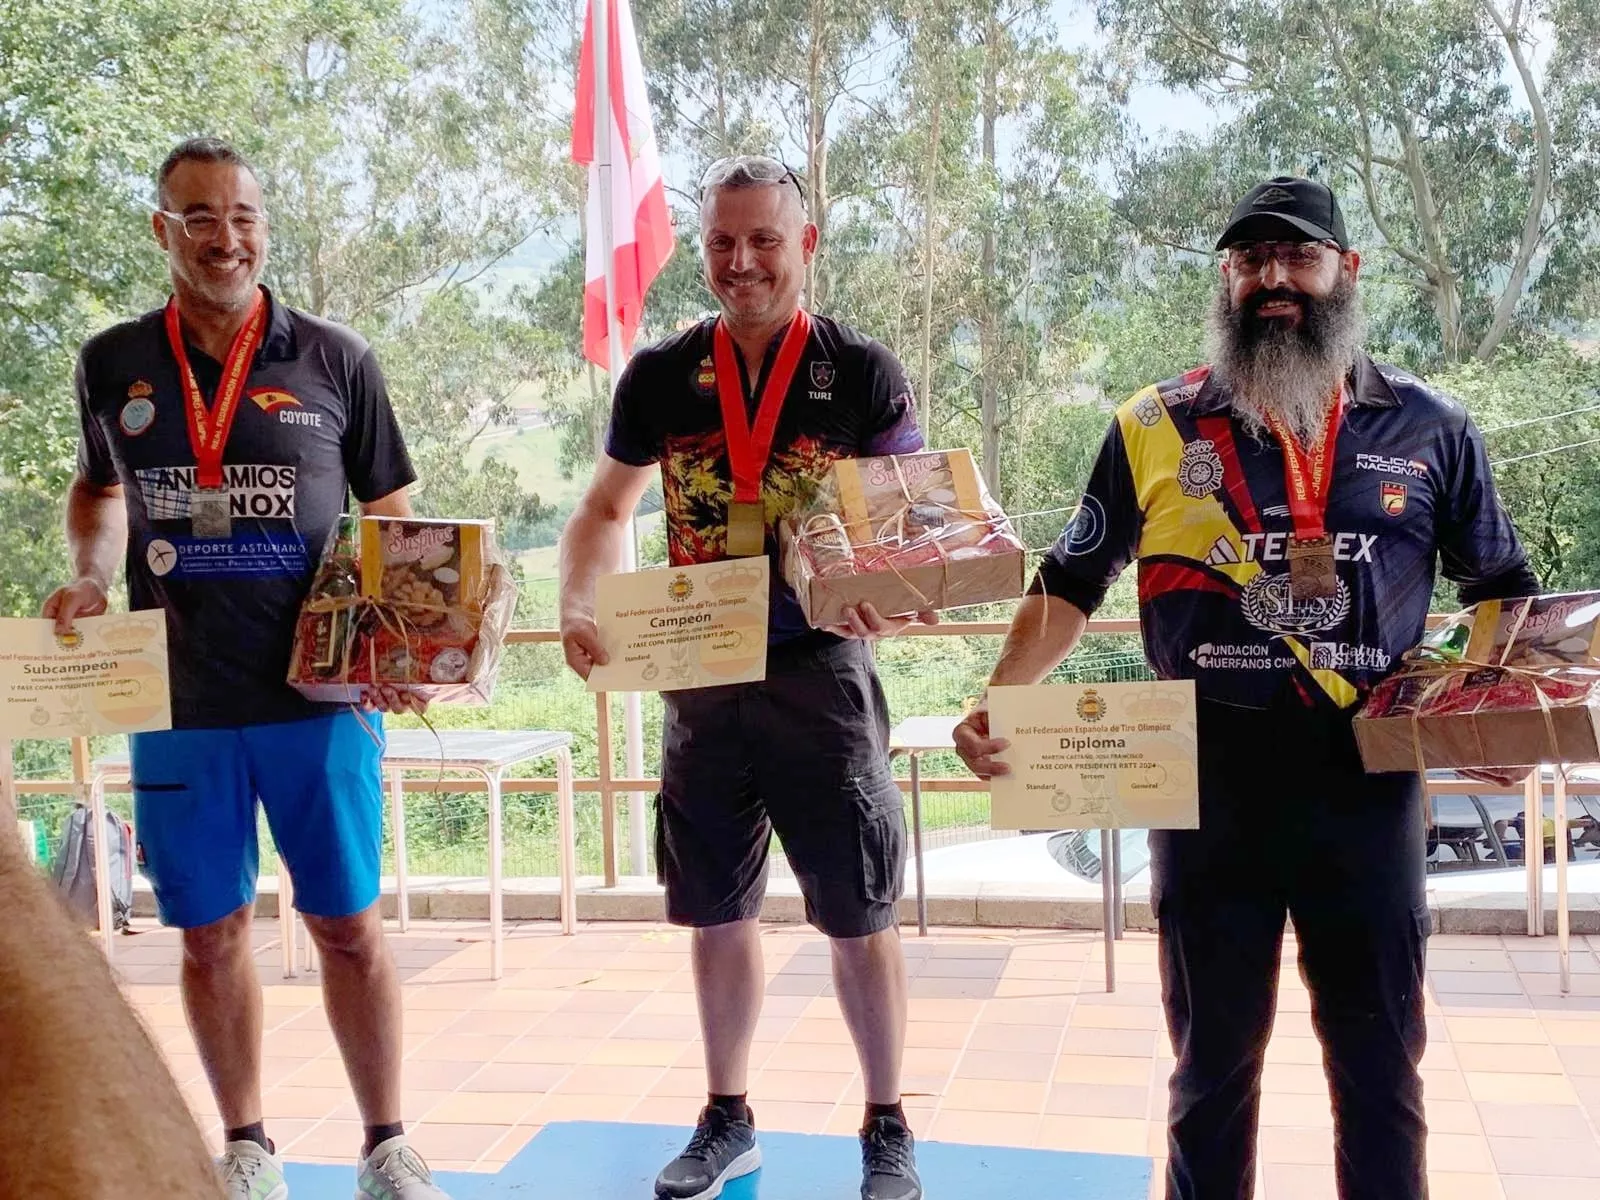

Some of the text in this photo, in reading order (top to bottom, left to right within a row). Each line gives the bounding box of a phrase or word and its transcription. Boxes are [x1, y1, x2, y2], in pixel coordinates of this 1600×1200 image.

[808, 391, 832, 401] TURI
[280, 410, 321, 427] COYOTE
[157, 466, 296, 491] ANMIOS
[868, 454, 941, 487] Supiros
[1356, 461, 1426, 482] NACIONAL
[1294, 476, 1307, 500] REAL
[388, 521, 454, 558] Suspiros
[1241, 532, 1378, 563] TEEX
[178, 544, 233, 554] DEPORTE
[650, 612, 711, 629] Campeón
[24, 660, 118, 674] Subcampeón
[1274, 657, 1296, 669] CNP
[1110, 725, 1119, 733] de
[1121, 724, 1135, 732] Tiro
[1060, 737, 1126, 752] Diploma
[1075, 762, 1117, 770] PRESIDENTE
[1131, 782, 1158, 790] General
